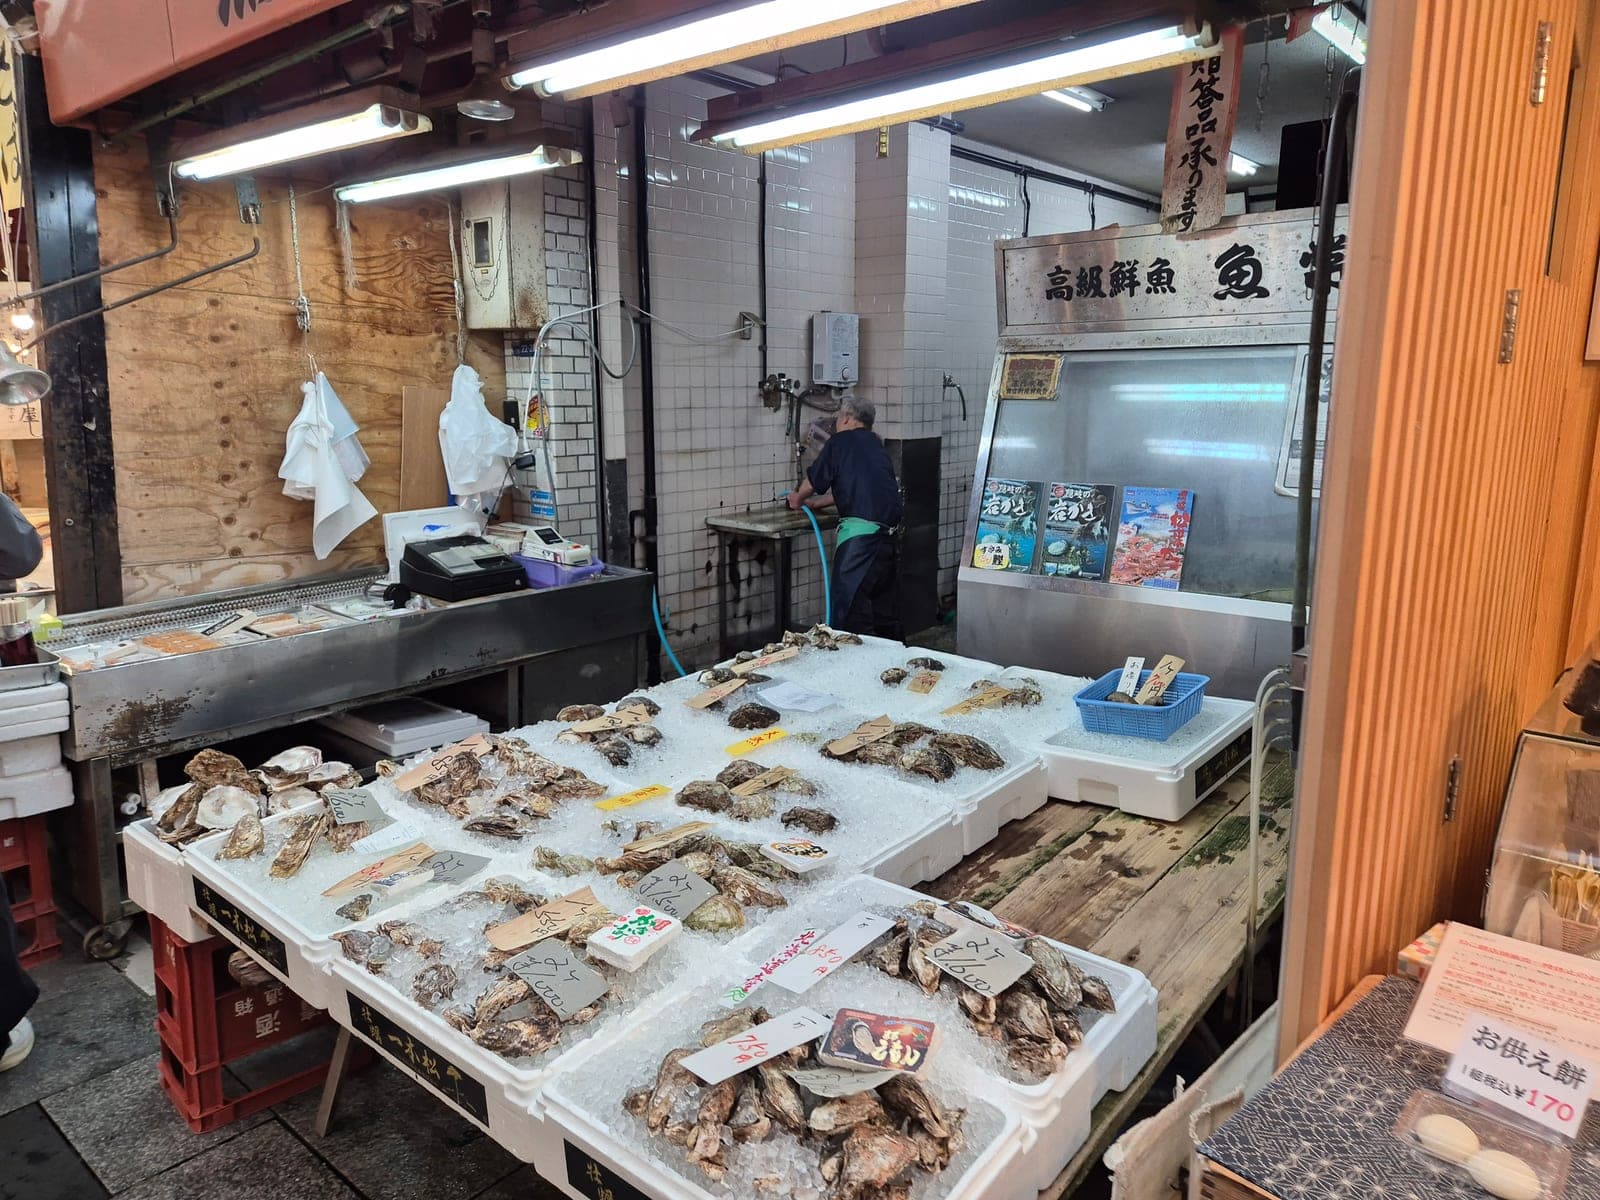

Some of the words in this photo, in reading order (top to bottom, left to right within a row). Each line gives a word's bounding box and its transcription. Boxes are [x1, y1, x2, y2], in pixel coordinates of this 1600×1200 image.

[1046, 257, 1176, 300] 高級鮮魚
[1472, 1025, 1588, 1090] お供え餅
